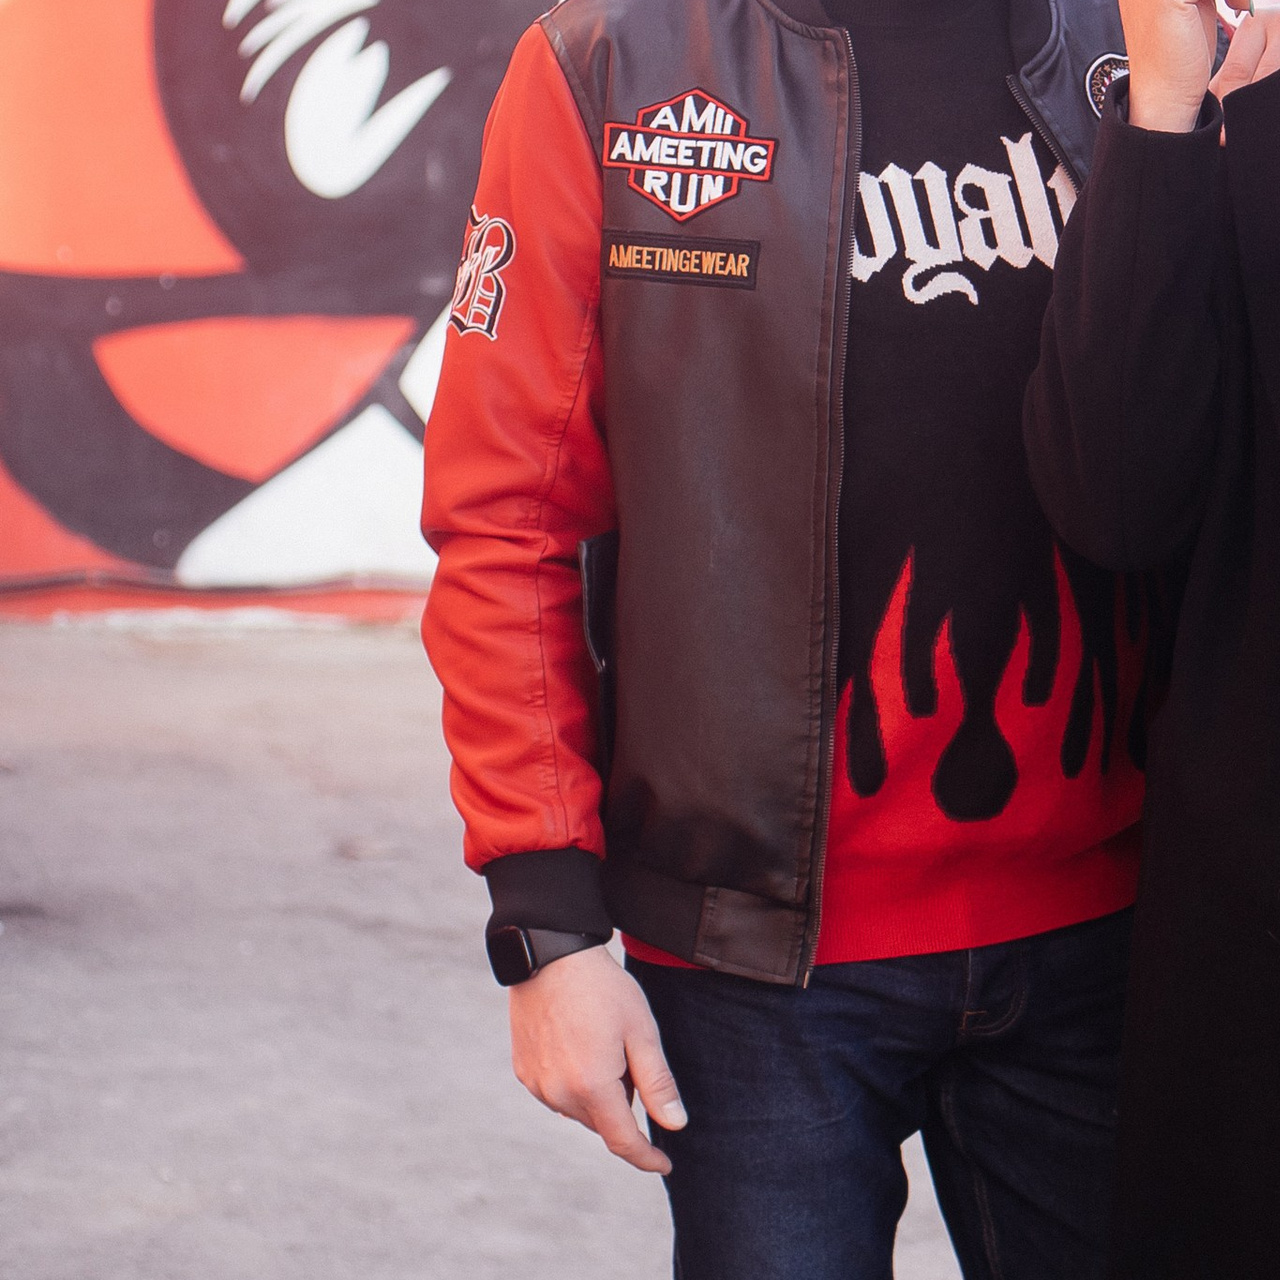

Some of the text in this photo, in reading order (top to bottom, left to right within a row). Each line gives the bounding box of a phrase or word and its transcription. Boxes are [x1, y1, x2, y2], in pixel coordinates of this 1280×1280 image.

[610, 131, 768, 173] AMEETING
[643, 170, 725, 213] RUN
[609, 244, 751, 278] AMEETINGEWEAR
